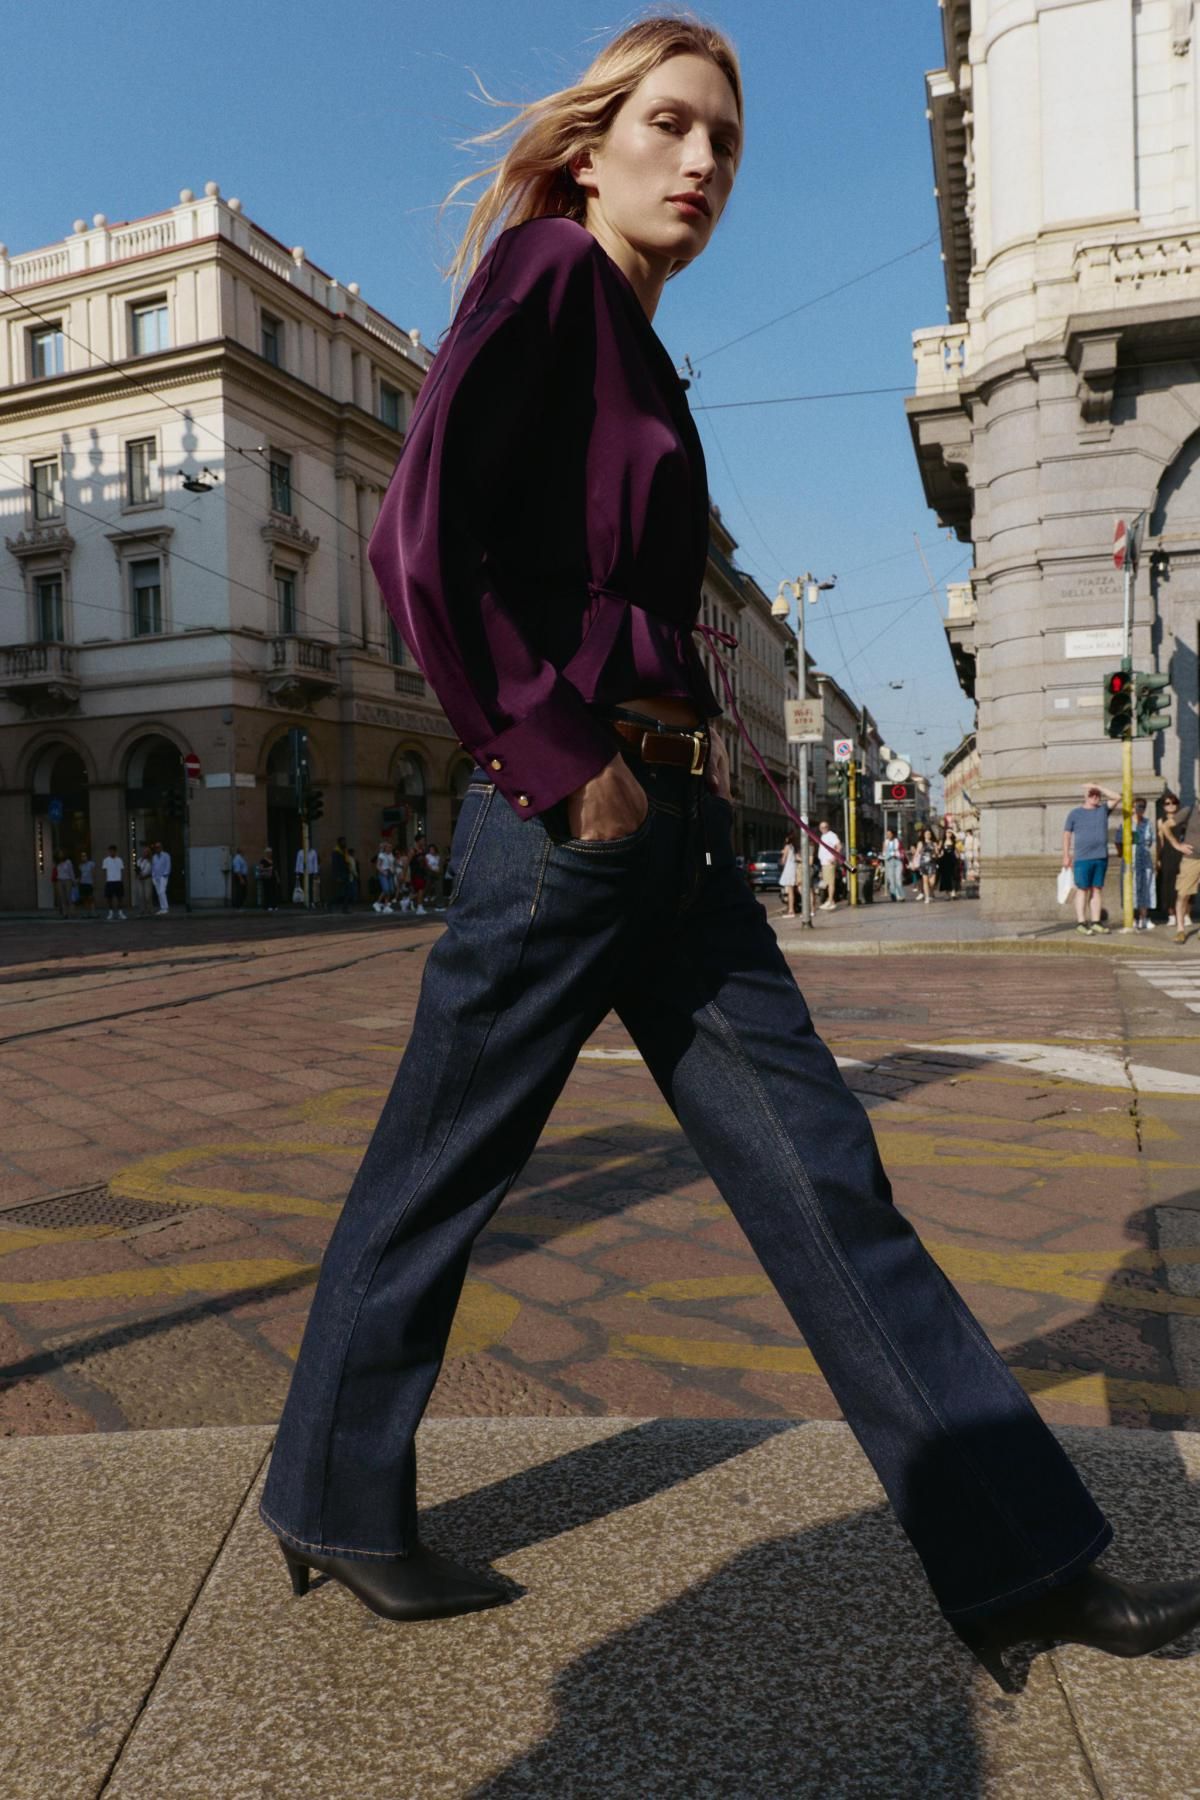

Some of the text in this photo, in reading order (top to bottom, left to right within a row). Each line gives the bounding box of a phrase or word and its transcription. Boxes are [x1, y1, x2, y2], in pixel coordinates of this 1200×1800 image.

[1078, 576, 1115, 586] PIAZZA
[1061, 585, 1123, 598] DELLA SCAL
